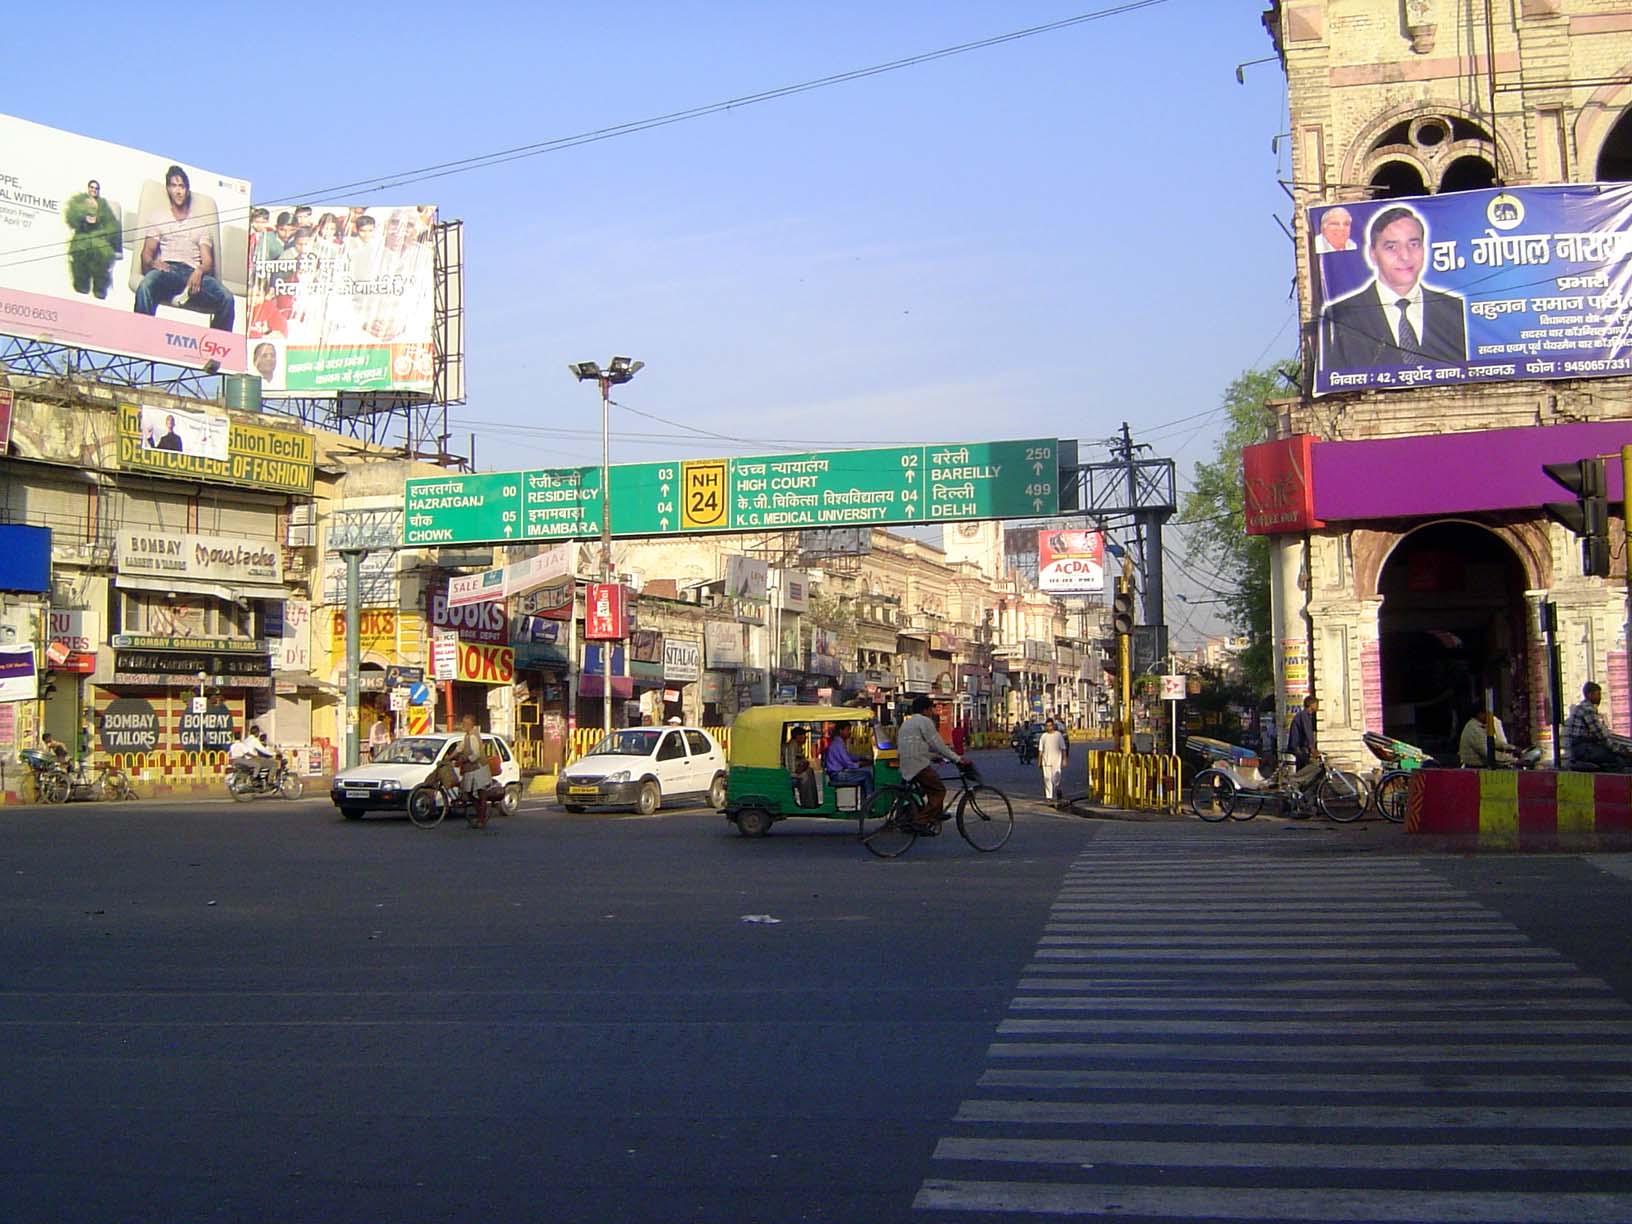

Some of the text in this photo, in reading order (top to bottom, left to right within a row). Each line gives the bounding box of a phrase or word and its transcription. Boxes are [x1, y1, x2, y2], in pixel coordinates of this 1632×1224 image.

[14, 192, 41, 206] WITH
[43, 198, 59, 210] ME
[1432, 240, 1465, 272] डा.
[1473, 229, 1550, 266] गोपाल
[1470, 298, 1526, 320] बहुजन
[1531, 296, 1584, 312] समाज
[165, 332, 198, 350] TATA
[1330, 372, 1368, 386] निवास
[1468, 364, 1515, 378] लखनऊ
[1526, 359, 1554, 373] फोन
[901, 455, 918, 468] 02
[1025, 448, 1051, 460] 250
[233, 456, 251, 478] OF
[253, 458, 309, 488] FASHION
[658, 468, 674, 481] 03
[738, 459, 829, 477] उच्च न्यायालय
[931, 465, 1001, 481] BAREILLY
[692, 473, 718, 488] NH
[737, 476, 818, 492] HIGH COURT
[410, 481, 463, 497] हजरतगंज
[502, 485, 517, 497] 00
[528, 488, 599, 503] RESIDENCY
[901, 490, 918, 502] 04
[933, 482, 975, 501] दिल्ली
[1025, 484, 1051, 496] 499
[409, 496, 484, 510] HAZRATGANJ
[691, 491, 719, 513] 24
[824, 489, 894, 506] विश्वविद्यालय
[658, 502, 673, 513] 04
[932, 504, 976, 517] DELHI
[409, 513, 433, 528] चौक
[502, 511, 517, 523] 05
[764, 511, 814, 525] MEDICAL
[818, 507, 887, 522] UNIVERSITY
[409, 528, 452, 541] CHOWK
[528, 521, 598, 535] IMAMBARA
[131, 537, 276, 568] BOMBAY Moustache
[453, 580, 479, 593] SALE
[433, 595, 504, 631] BOOKS
[334, 611, 394, 635] BOKS
[105, 714, 230, 729] BOMBAY BOMBAY
[108, 730, 156, 749] TAILORS
